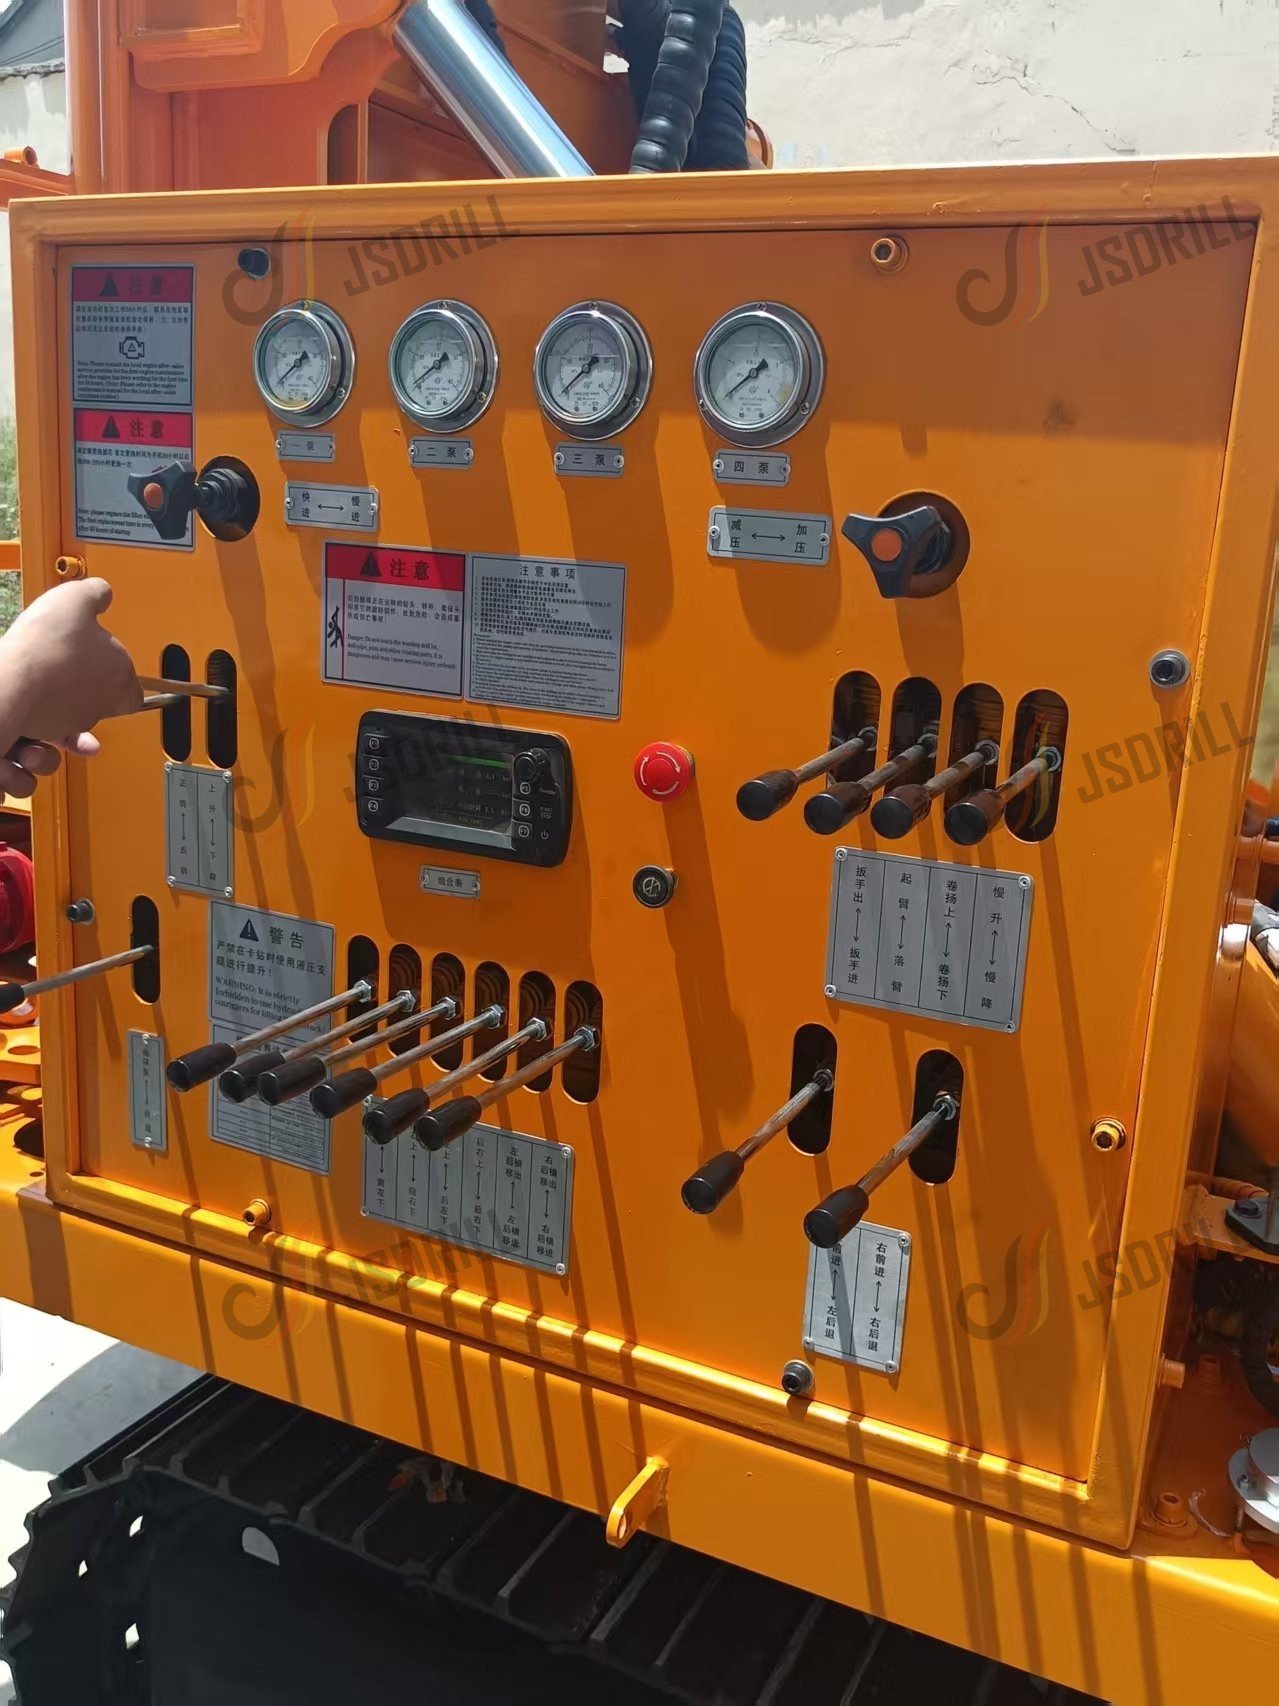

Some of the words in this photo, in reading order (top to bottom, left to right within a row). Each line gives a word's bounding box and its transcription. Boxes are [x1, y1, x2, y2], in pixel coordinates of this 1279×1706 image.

[130, 419, 164, 438] 注意
[426, 446, 457, 458] 二泵
[572, 454, 606, 466] 三泵
[734, 460, 769, 474] 四泵
[794, 523, 808, 554] 加压
[390, 558, 430, 580] 注意
[520, 564, 576, 580] 注意事项
[854, 866, 866, 904] 扳手出
[898, 873, 912, 910] 起臂
[944, 880, 958, 918] 卷扬上
[990, 886, 1004, 924] 慢升
[269, 926, 304, 949] 警告
[848, 948, 860, 984] 扳手进
[892, 956, 904, 992] 落臂
[937, 964, 950, 1000] 卷扬下
[980, 971, 996, 1010] 慢降
[874, 1242, 888, 1278] 右前进
[824, 1305, 838, 1340] 左后退
[868, 1318, 881, 1352] 右后退
